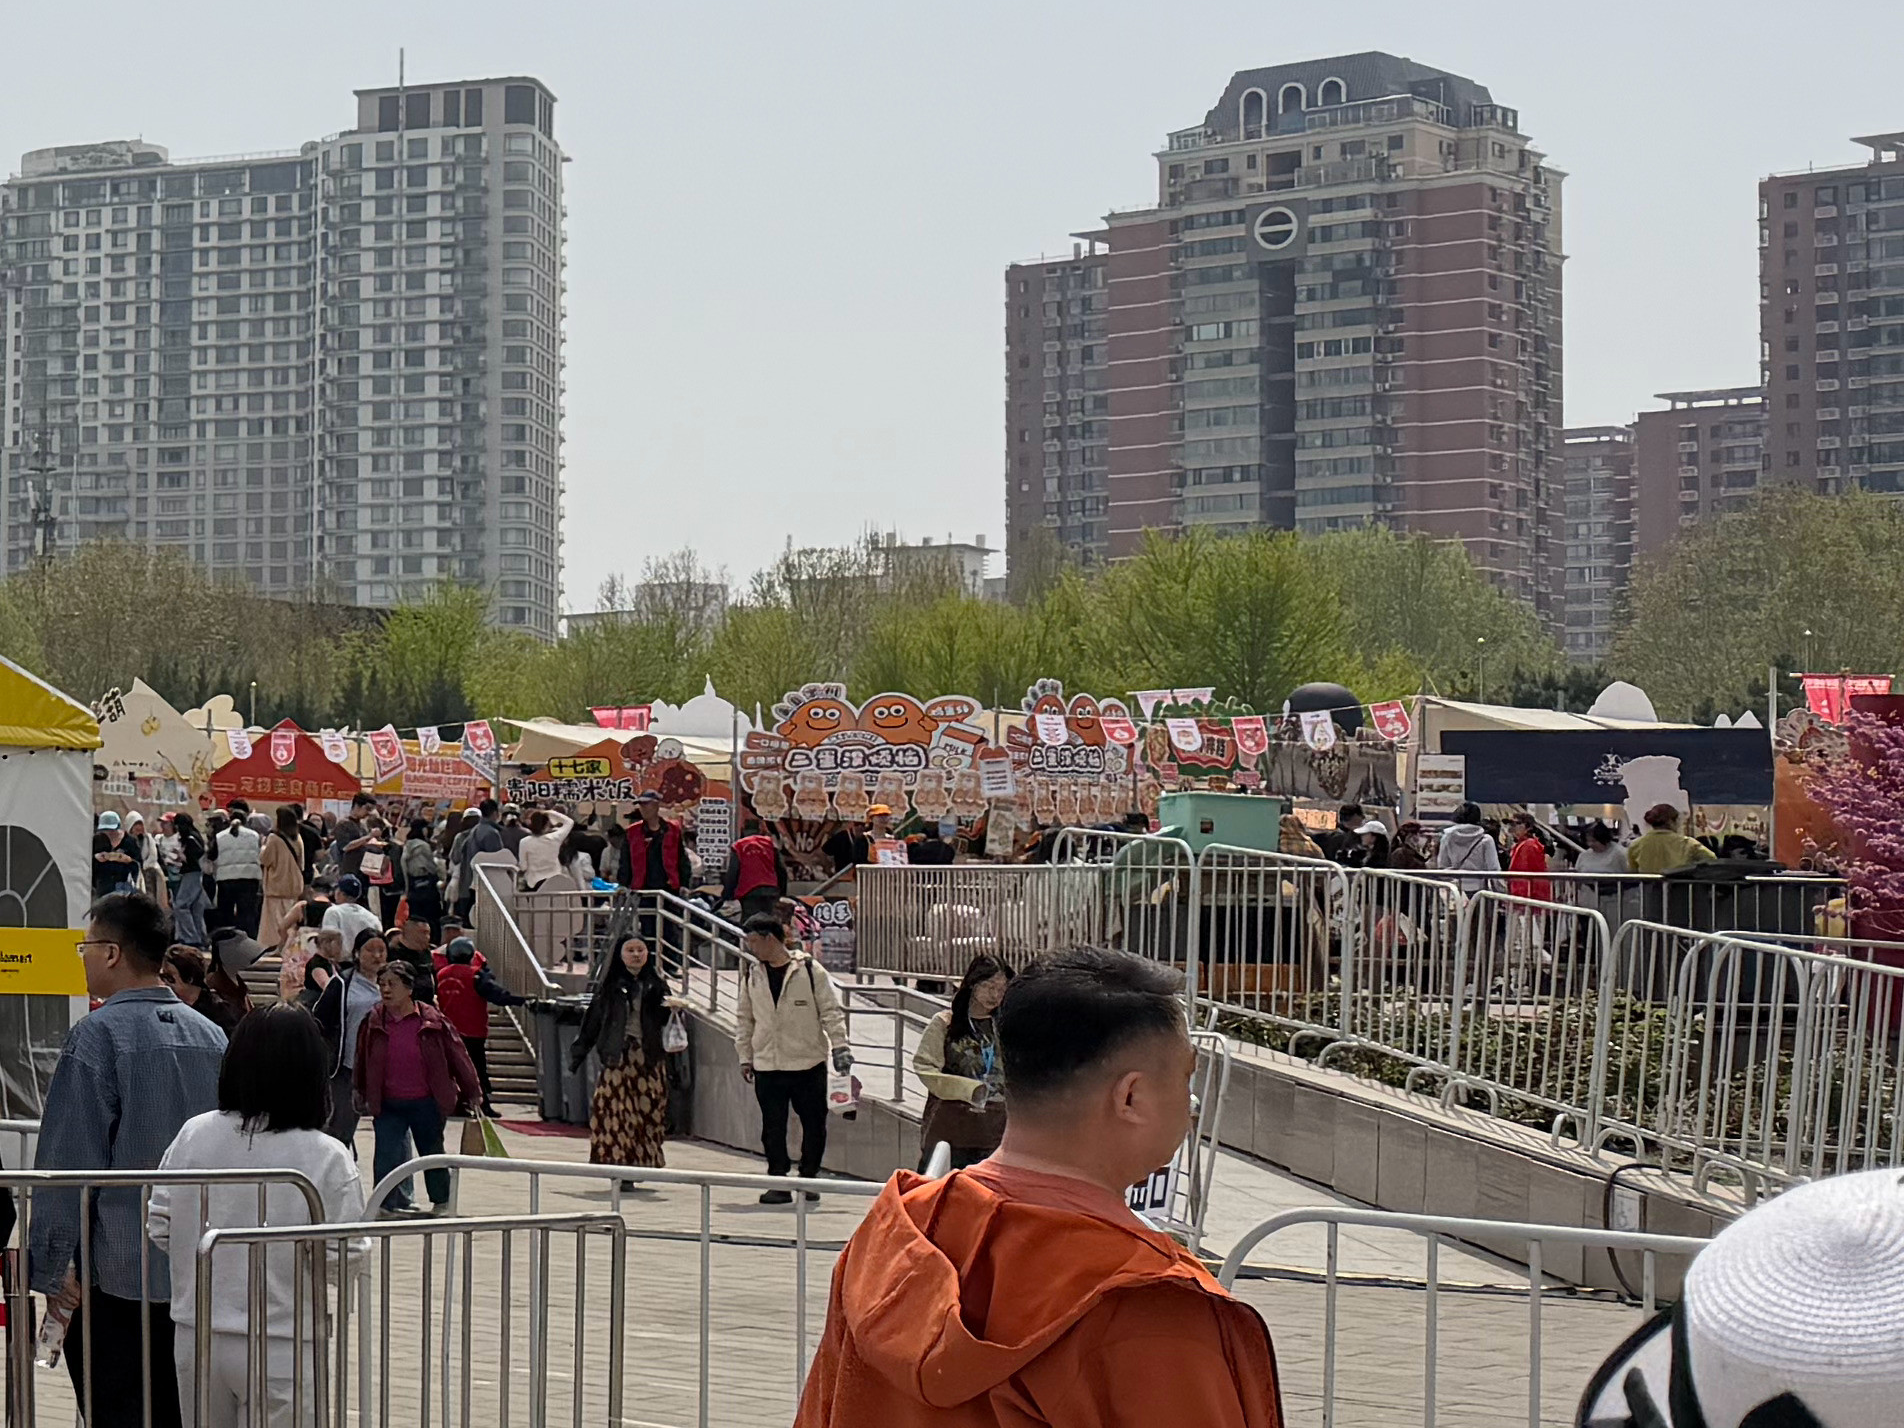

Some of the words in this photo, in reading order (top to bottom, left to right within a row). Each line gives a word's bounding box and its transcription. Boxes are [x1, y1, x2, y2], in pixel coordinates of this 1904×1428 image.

[507, 777, 637, 803] 贵阳糯米饭
